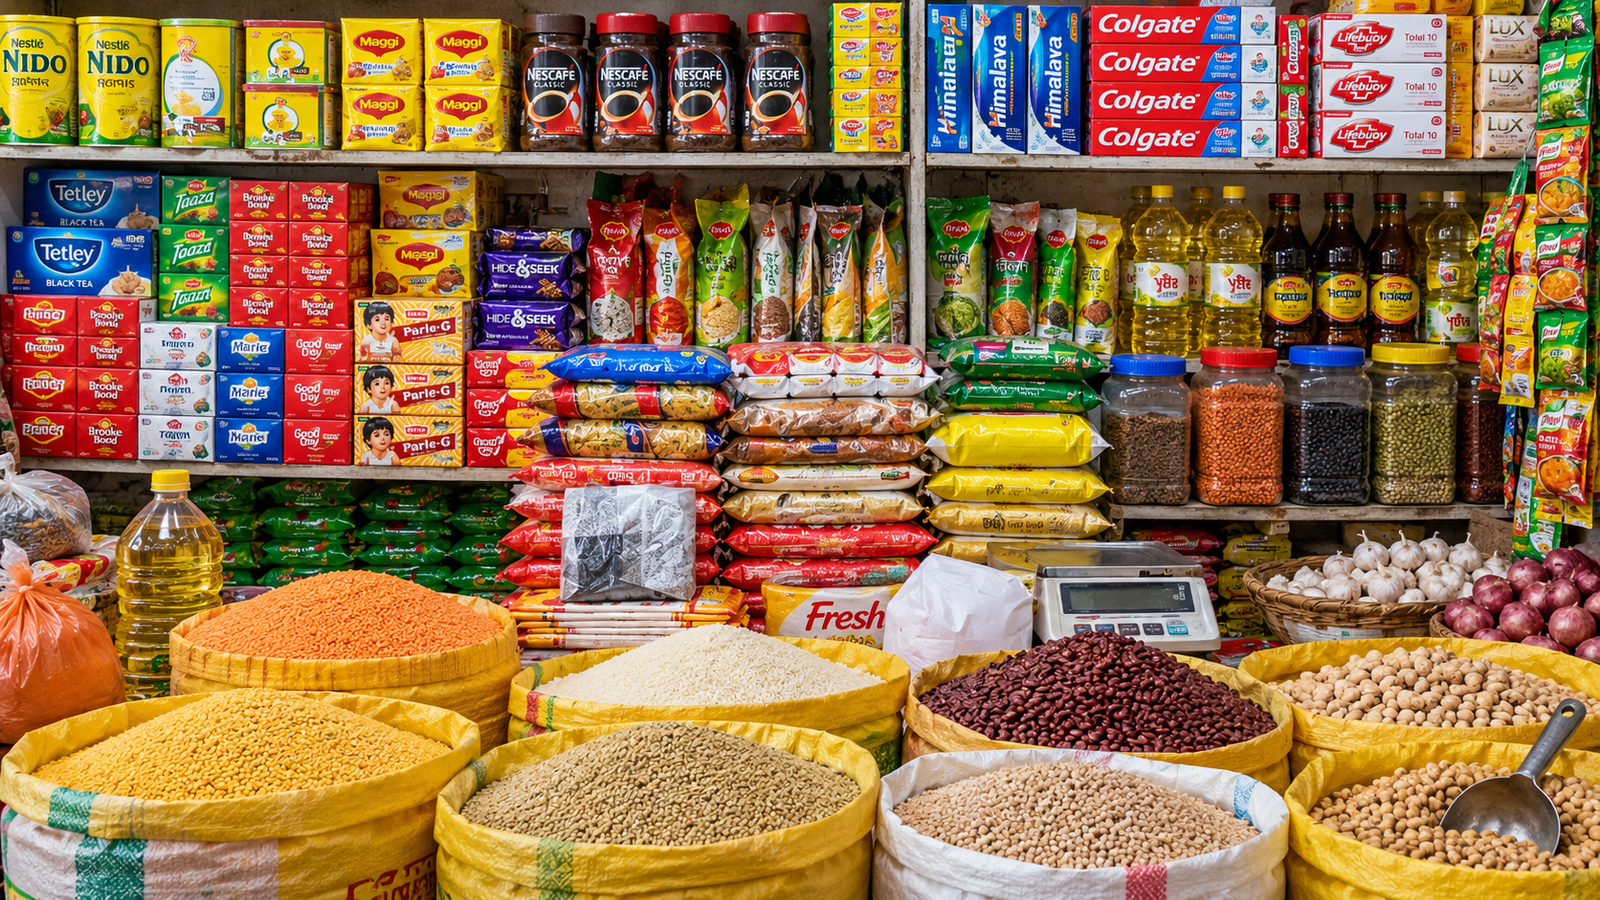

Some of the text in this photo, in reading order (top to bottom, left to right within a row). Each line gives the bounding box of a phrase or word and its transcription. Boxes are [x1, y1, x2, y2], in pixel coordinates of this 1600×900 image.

[1098, 13, 1197, 38] Colgate
[1404, 33, 1438, 41] Total 10
[360, 36, 399, 48] Maggi
[442, 36, 482, 49] Maggi
[1337, 32, 1388, 44] Lifebuoy
[3, 49, 67, 74] NIDO
[87, 50, 150, 76] NIDO
[1098, 52, 1197, 77] Colgate
[1337, 81, 1388, 93] Lifebuoy
[1404, 82, 1438, 91] Total 10
[1098, 90, 1197, 115] Colgate
[1098, 127, 1197, 152] Colgate
[1337, 129, 1388, 142] Lifebuoy
[1403, 131, 1438, 140] Total 10
[55, 184, 107, 207] Tetley
[174, 191, 215, 214] Taaza
[40, 243, 95, 266] Tetley
[172, 241, 213, 265] Taaza
[46, 278, 93, 288] BLACK TEA
[88, 426, 123, 436] Brooke
[805, 599, 886, 632] Fresh
